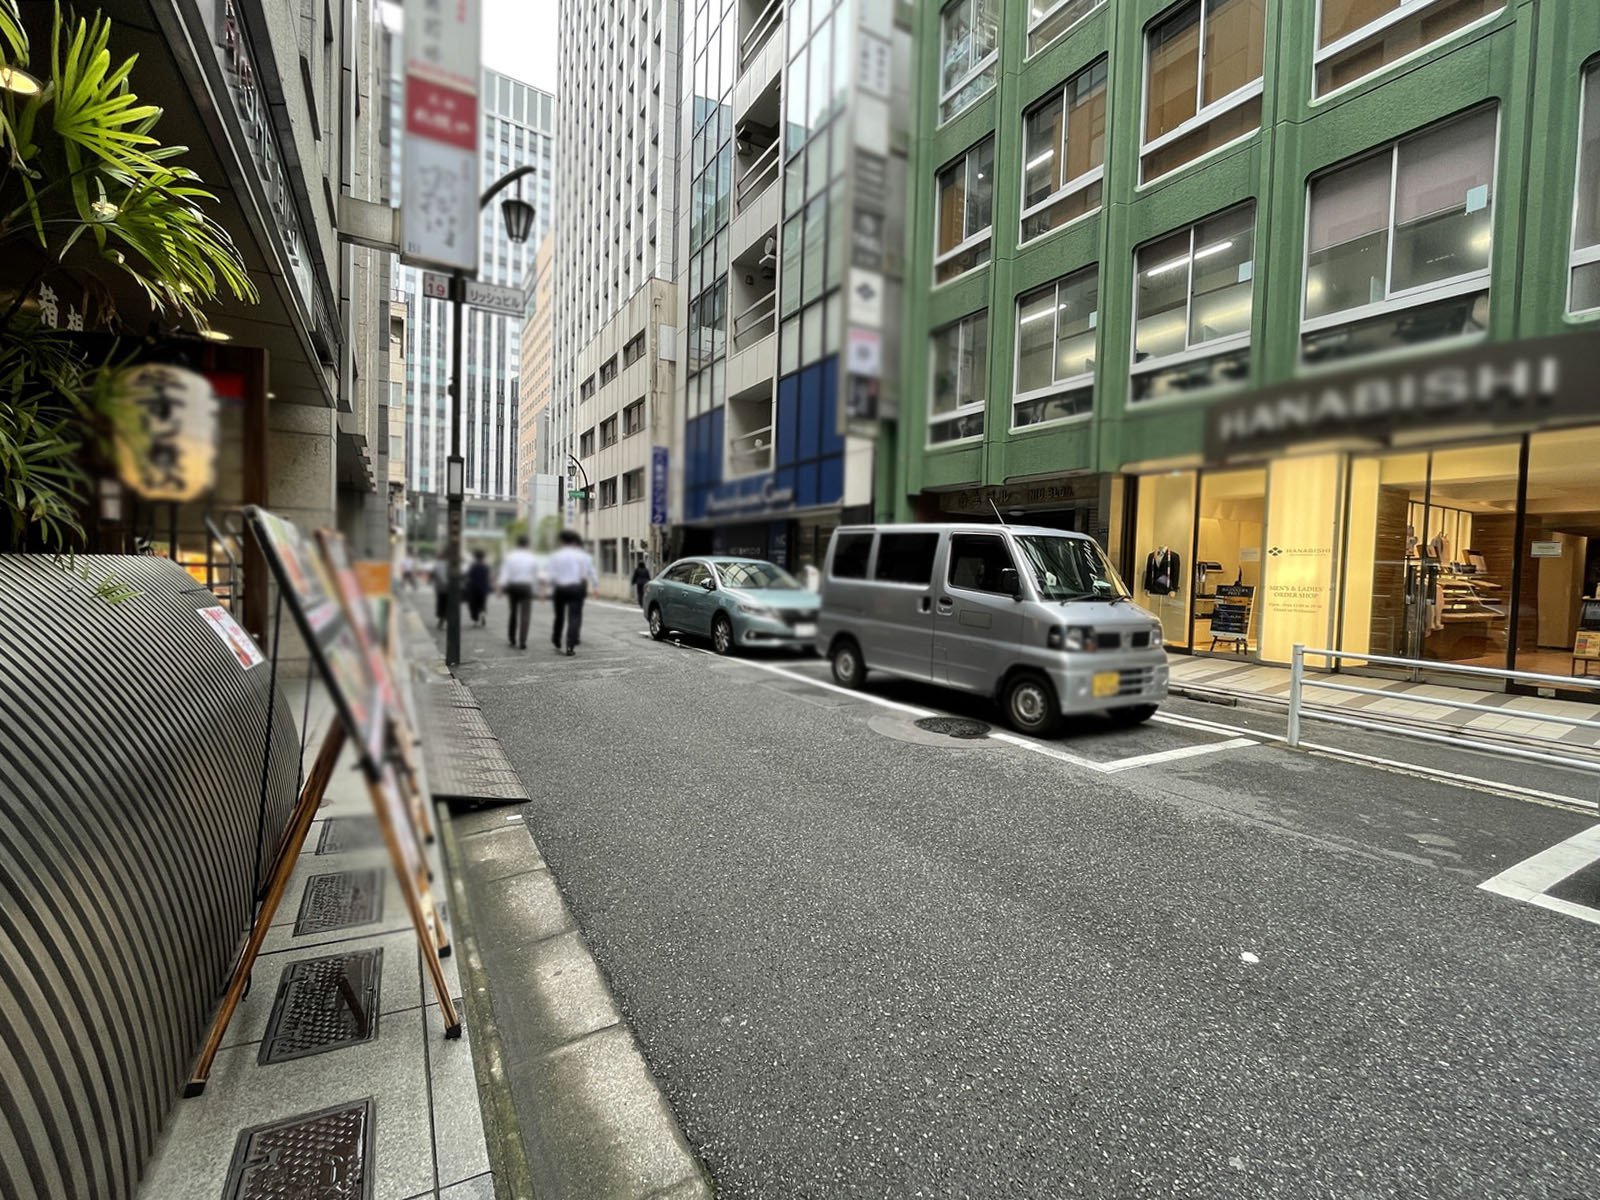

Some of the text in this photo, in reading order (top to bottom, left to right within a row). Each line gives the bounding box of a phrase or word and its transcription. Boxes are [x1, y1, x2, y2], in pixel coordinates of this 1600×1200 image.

[427, 282, 446, 297] 19
[470, 289, 519, 308] リッシュビル
